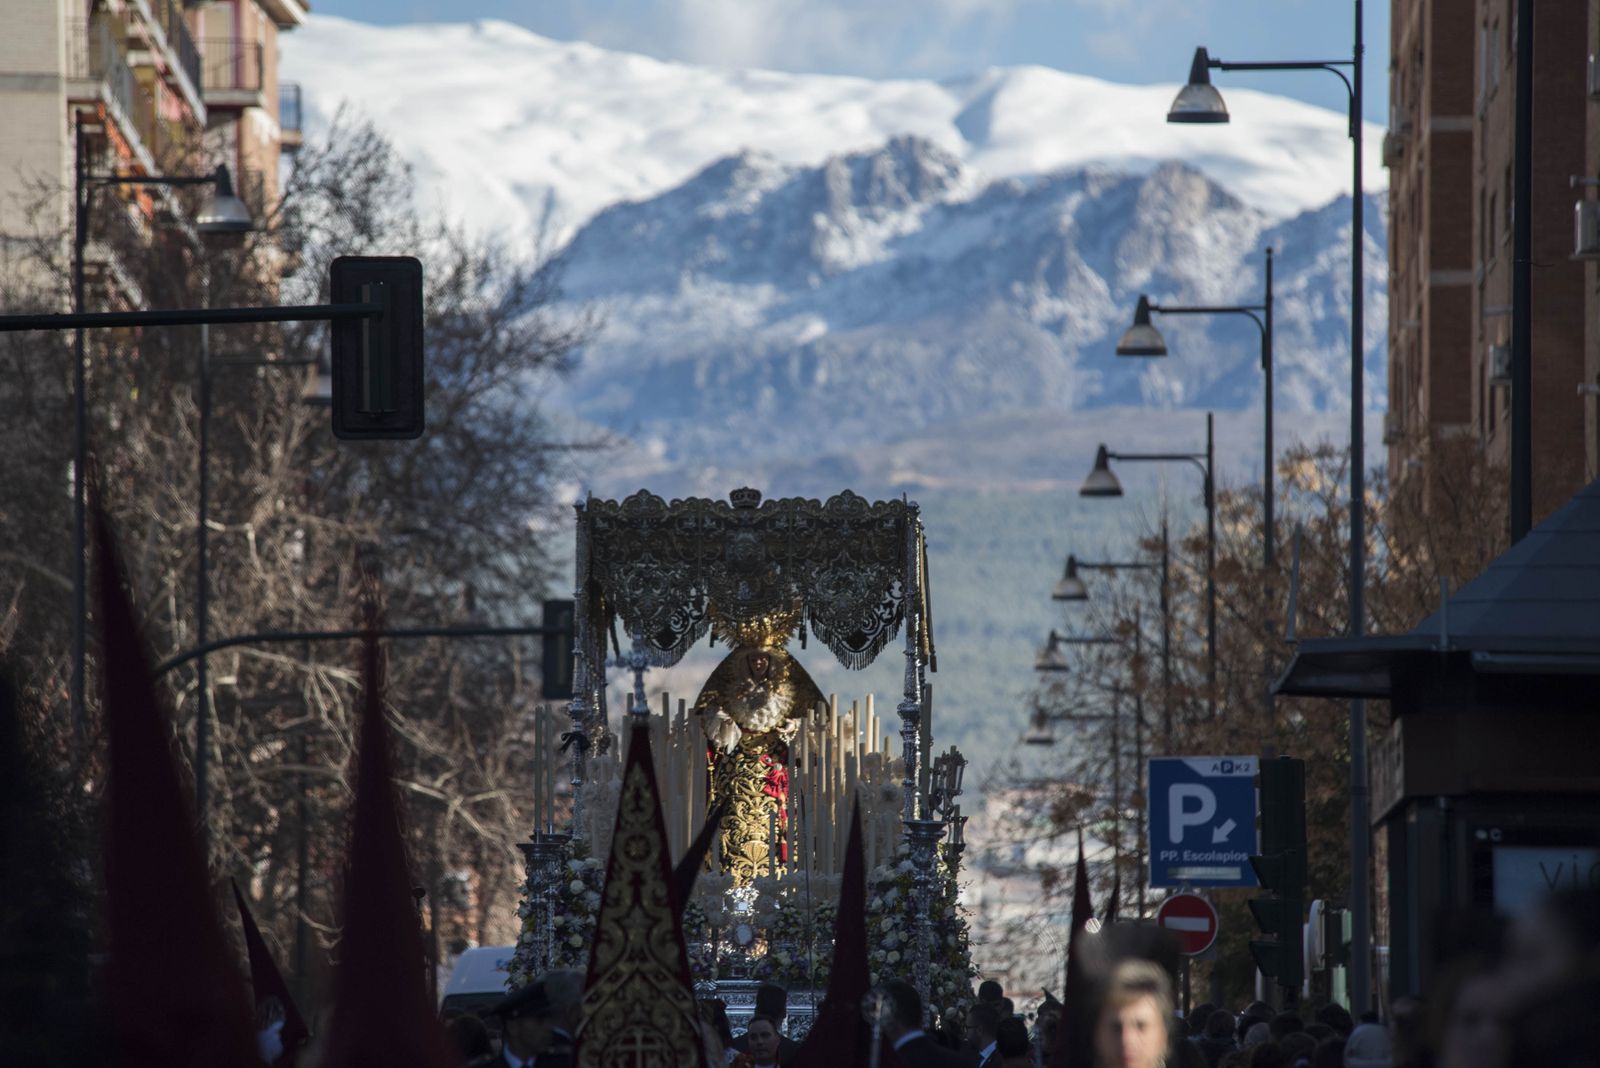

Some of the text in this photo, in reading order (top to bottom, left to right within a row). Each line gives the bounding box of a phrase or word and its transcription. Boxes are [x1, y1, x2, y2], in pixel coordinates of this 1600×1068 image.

[1168, 783, 1217, 844] P
[1160, 850, 1248, 864] PP. Escolapios
